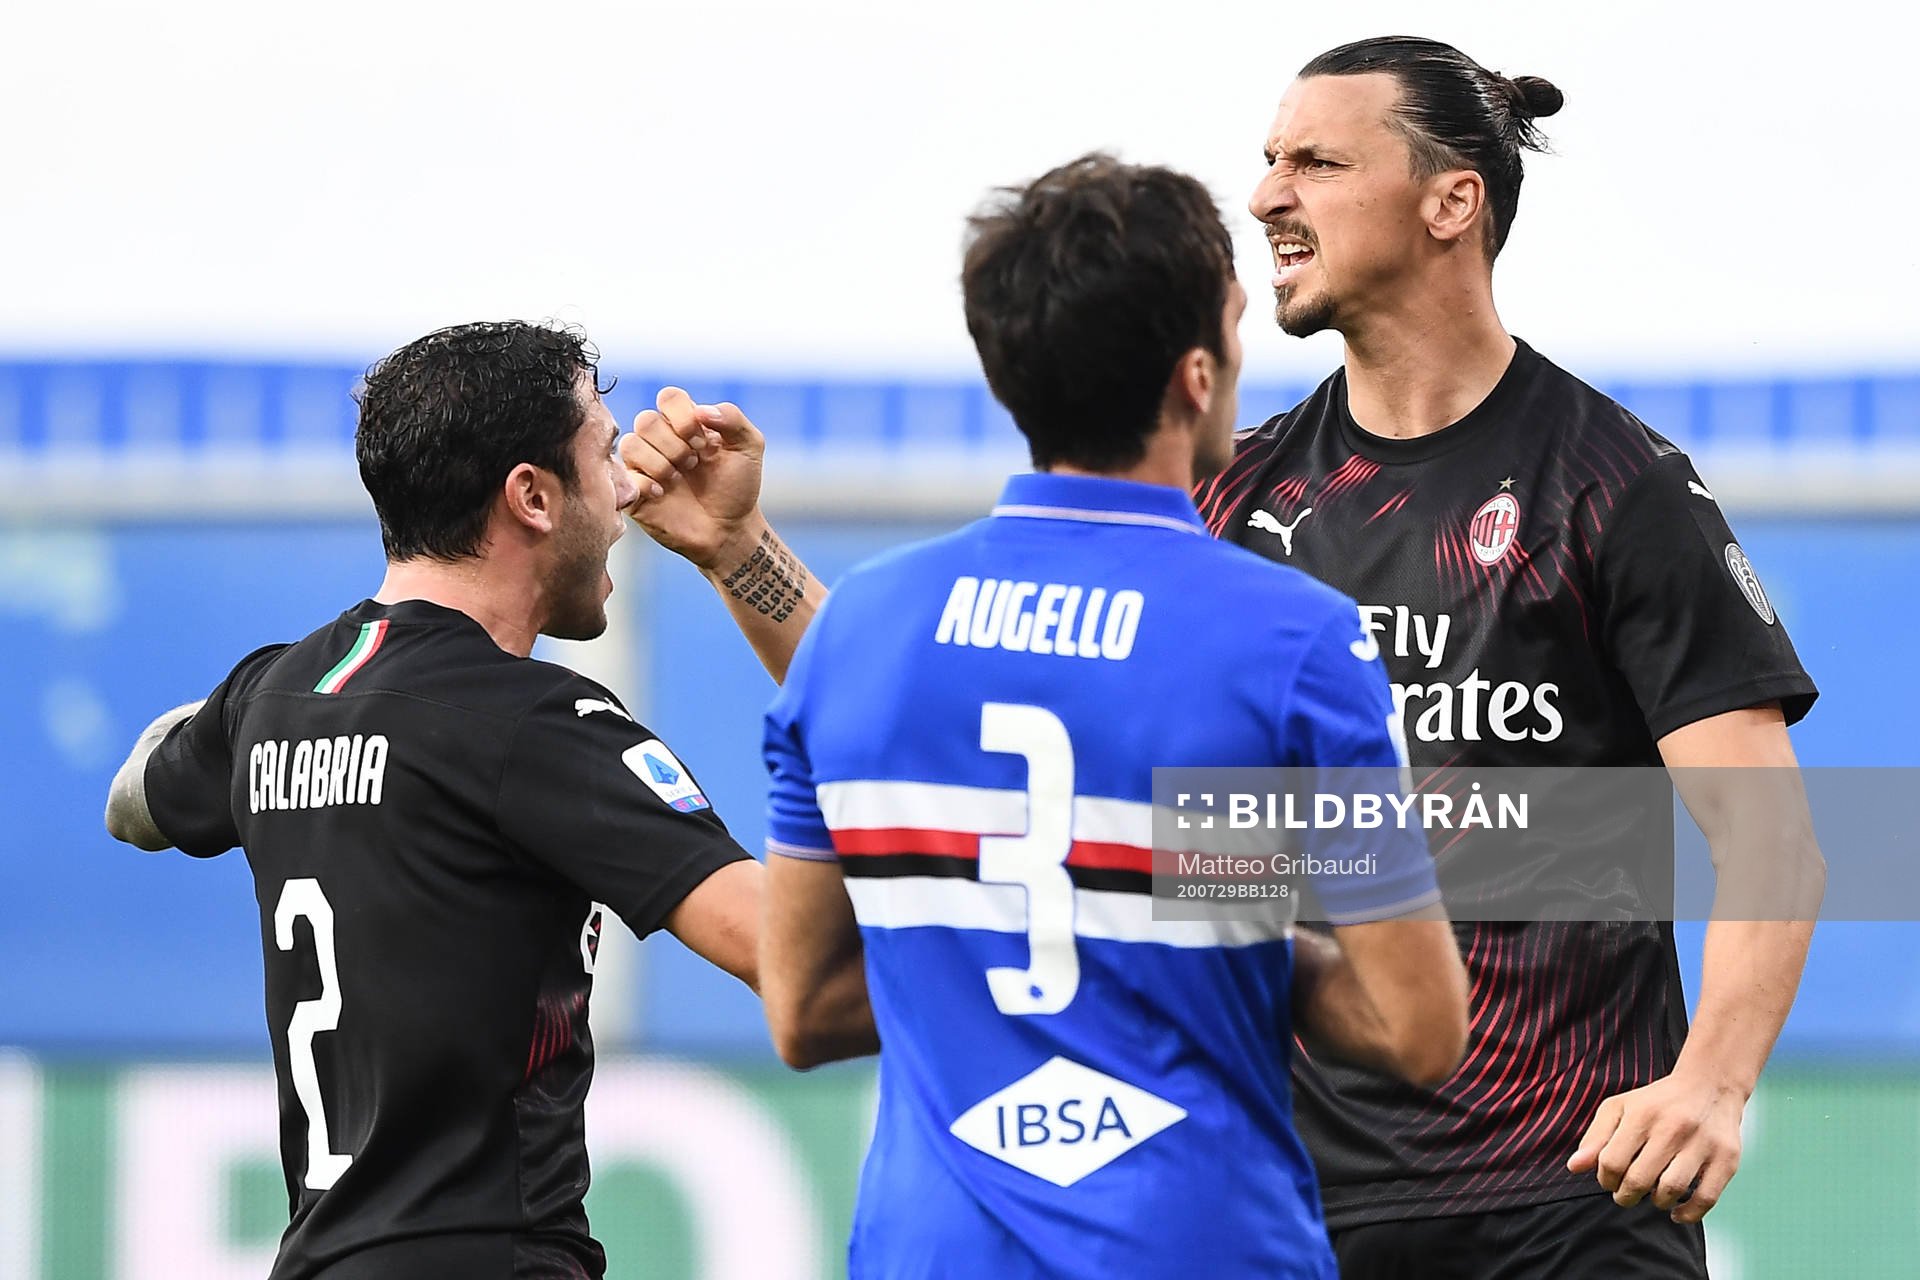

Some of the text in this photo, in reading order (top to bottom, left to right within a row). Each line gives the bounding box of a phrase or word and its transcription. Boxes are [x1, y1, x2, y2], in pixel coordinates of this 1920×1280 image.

[934, 575, 1145, 661] AUGELLO
[1356, 604, 1451, 669] Fly
[1388, 667, 1564, 743] rates
[249, 733, 389, 814] CALABRIA
[978, 701, 1080, 1016] 3
[274, 877, 354, 1191] 2
[996, 1096, 1133, 1149] IBSA
